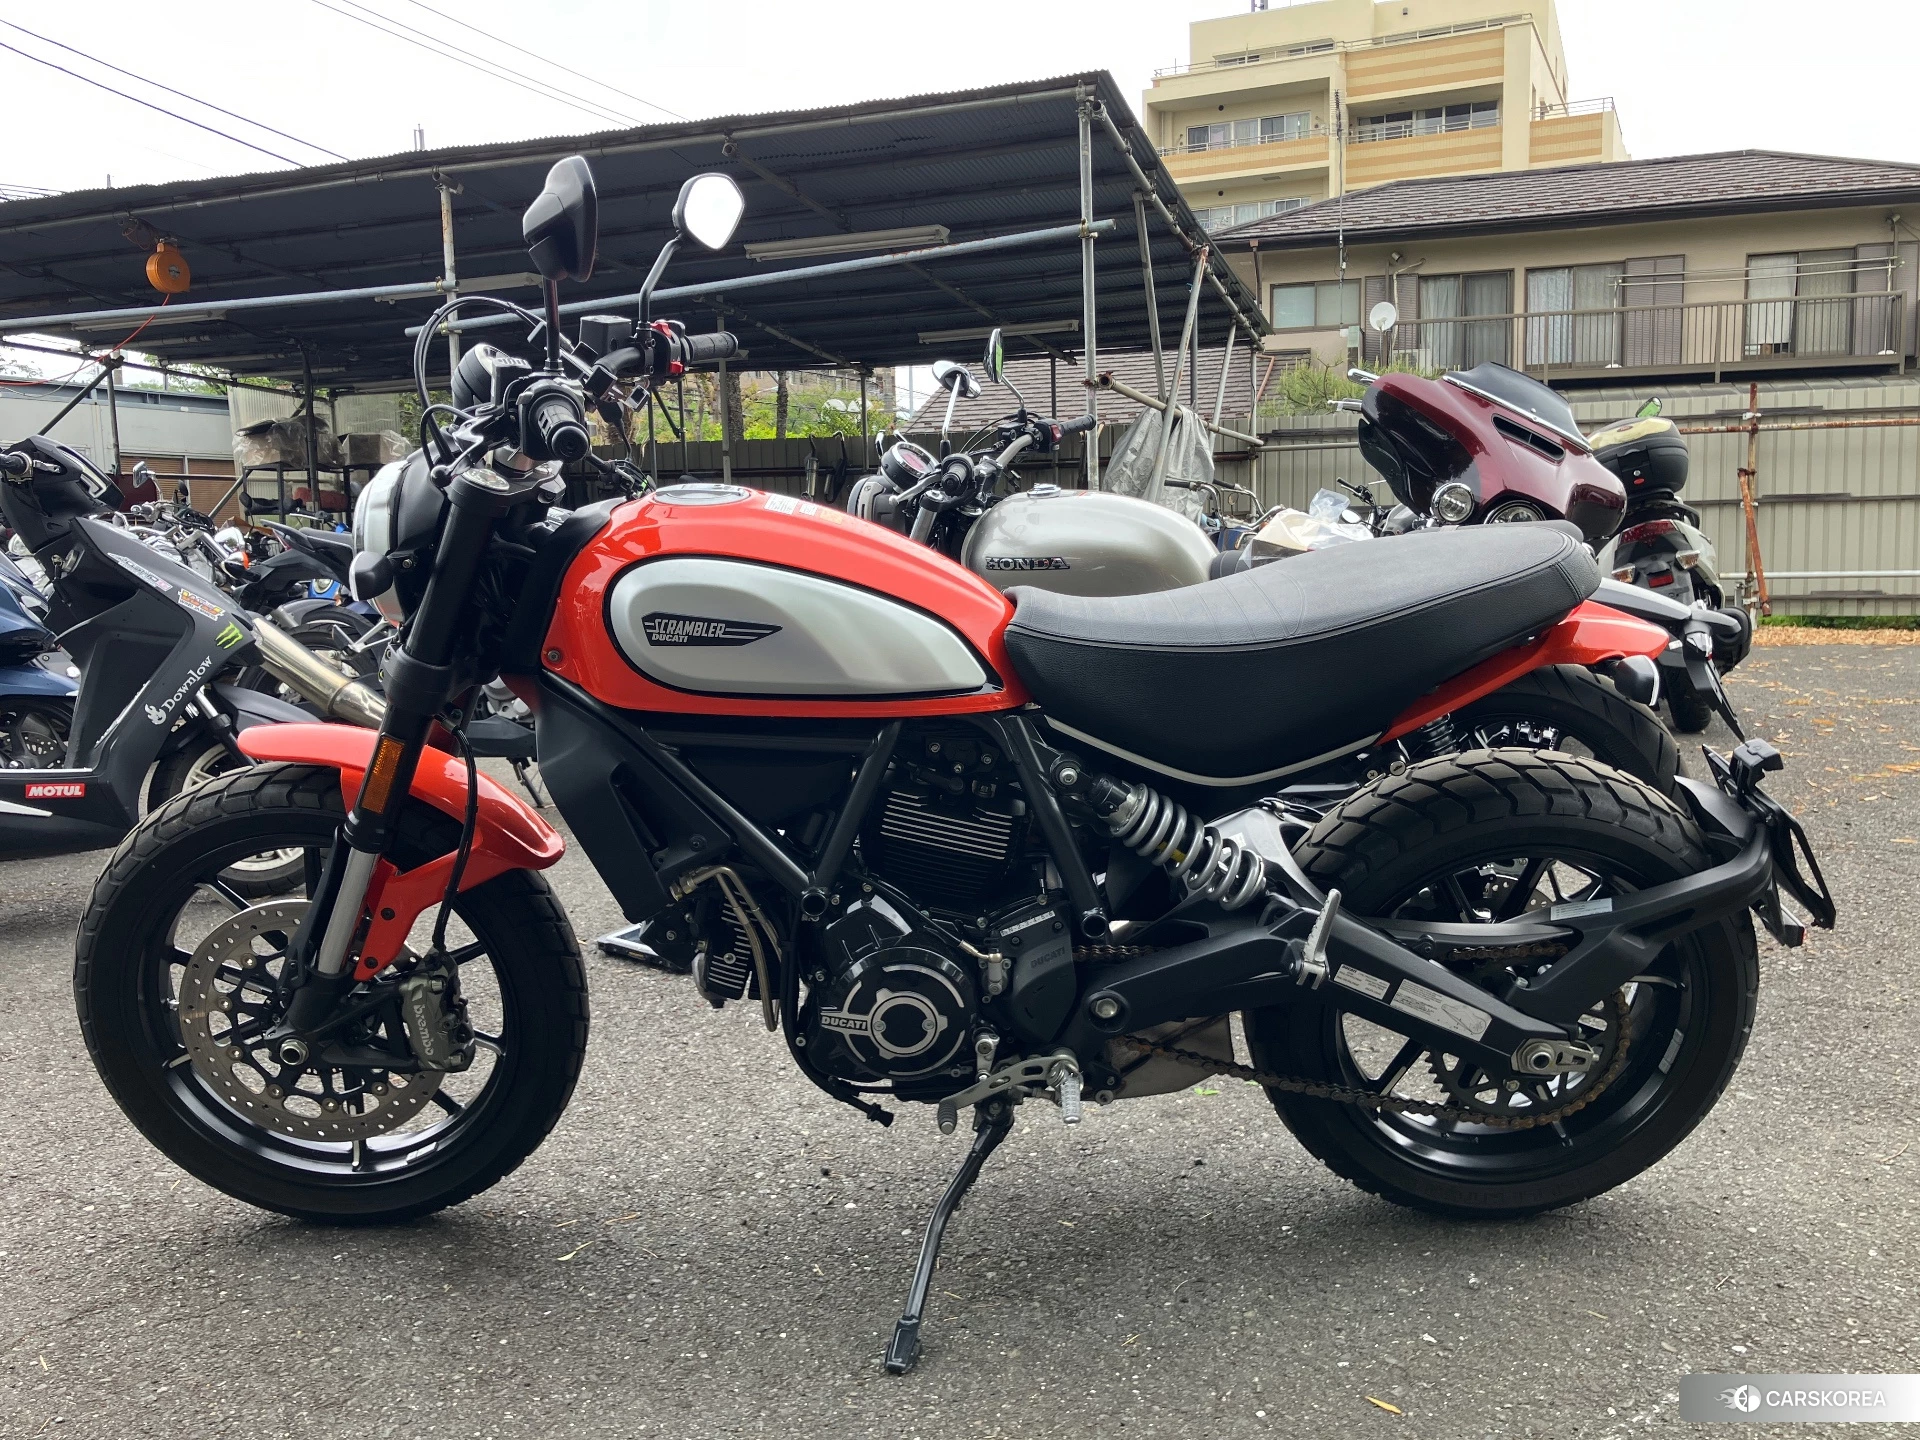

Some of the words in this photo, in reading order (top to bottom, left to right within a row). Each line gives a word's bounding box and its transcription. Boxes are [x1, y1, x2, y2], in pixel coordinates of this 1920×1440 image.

[984, 557, 1070, 570] HONDA
[654, 618, 726, 638] SCRAMBLER
[651, 633, 689, 643] DUCATI
[161, 655, 213, 712] Downlow
[28, 785, 82, 797] MOTUL
[1030, 946, 1065, 969] DUCATI
[413, 1004, 434, 1056] brembo
[821, 1015, 867, 1030] DUCATI
